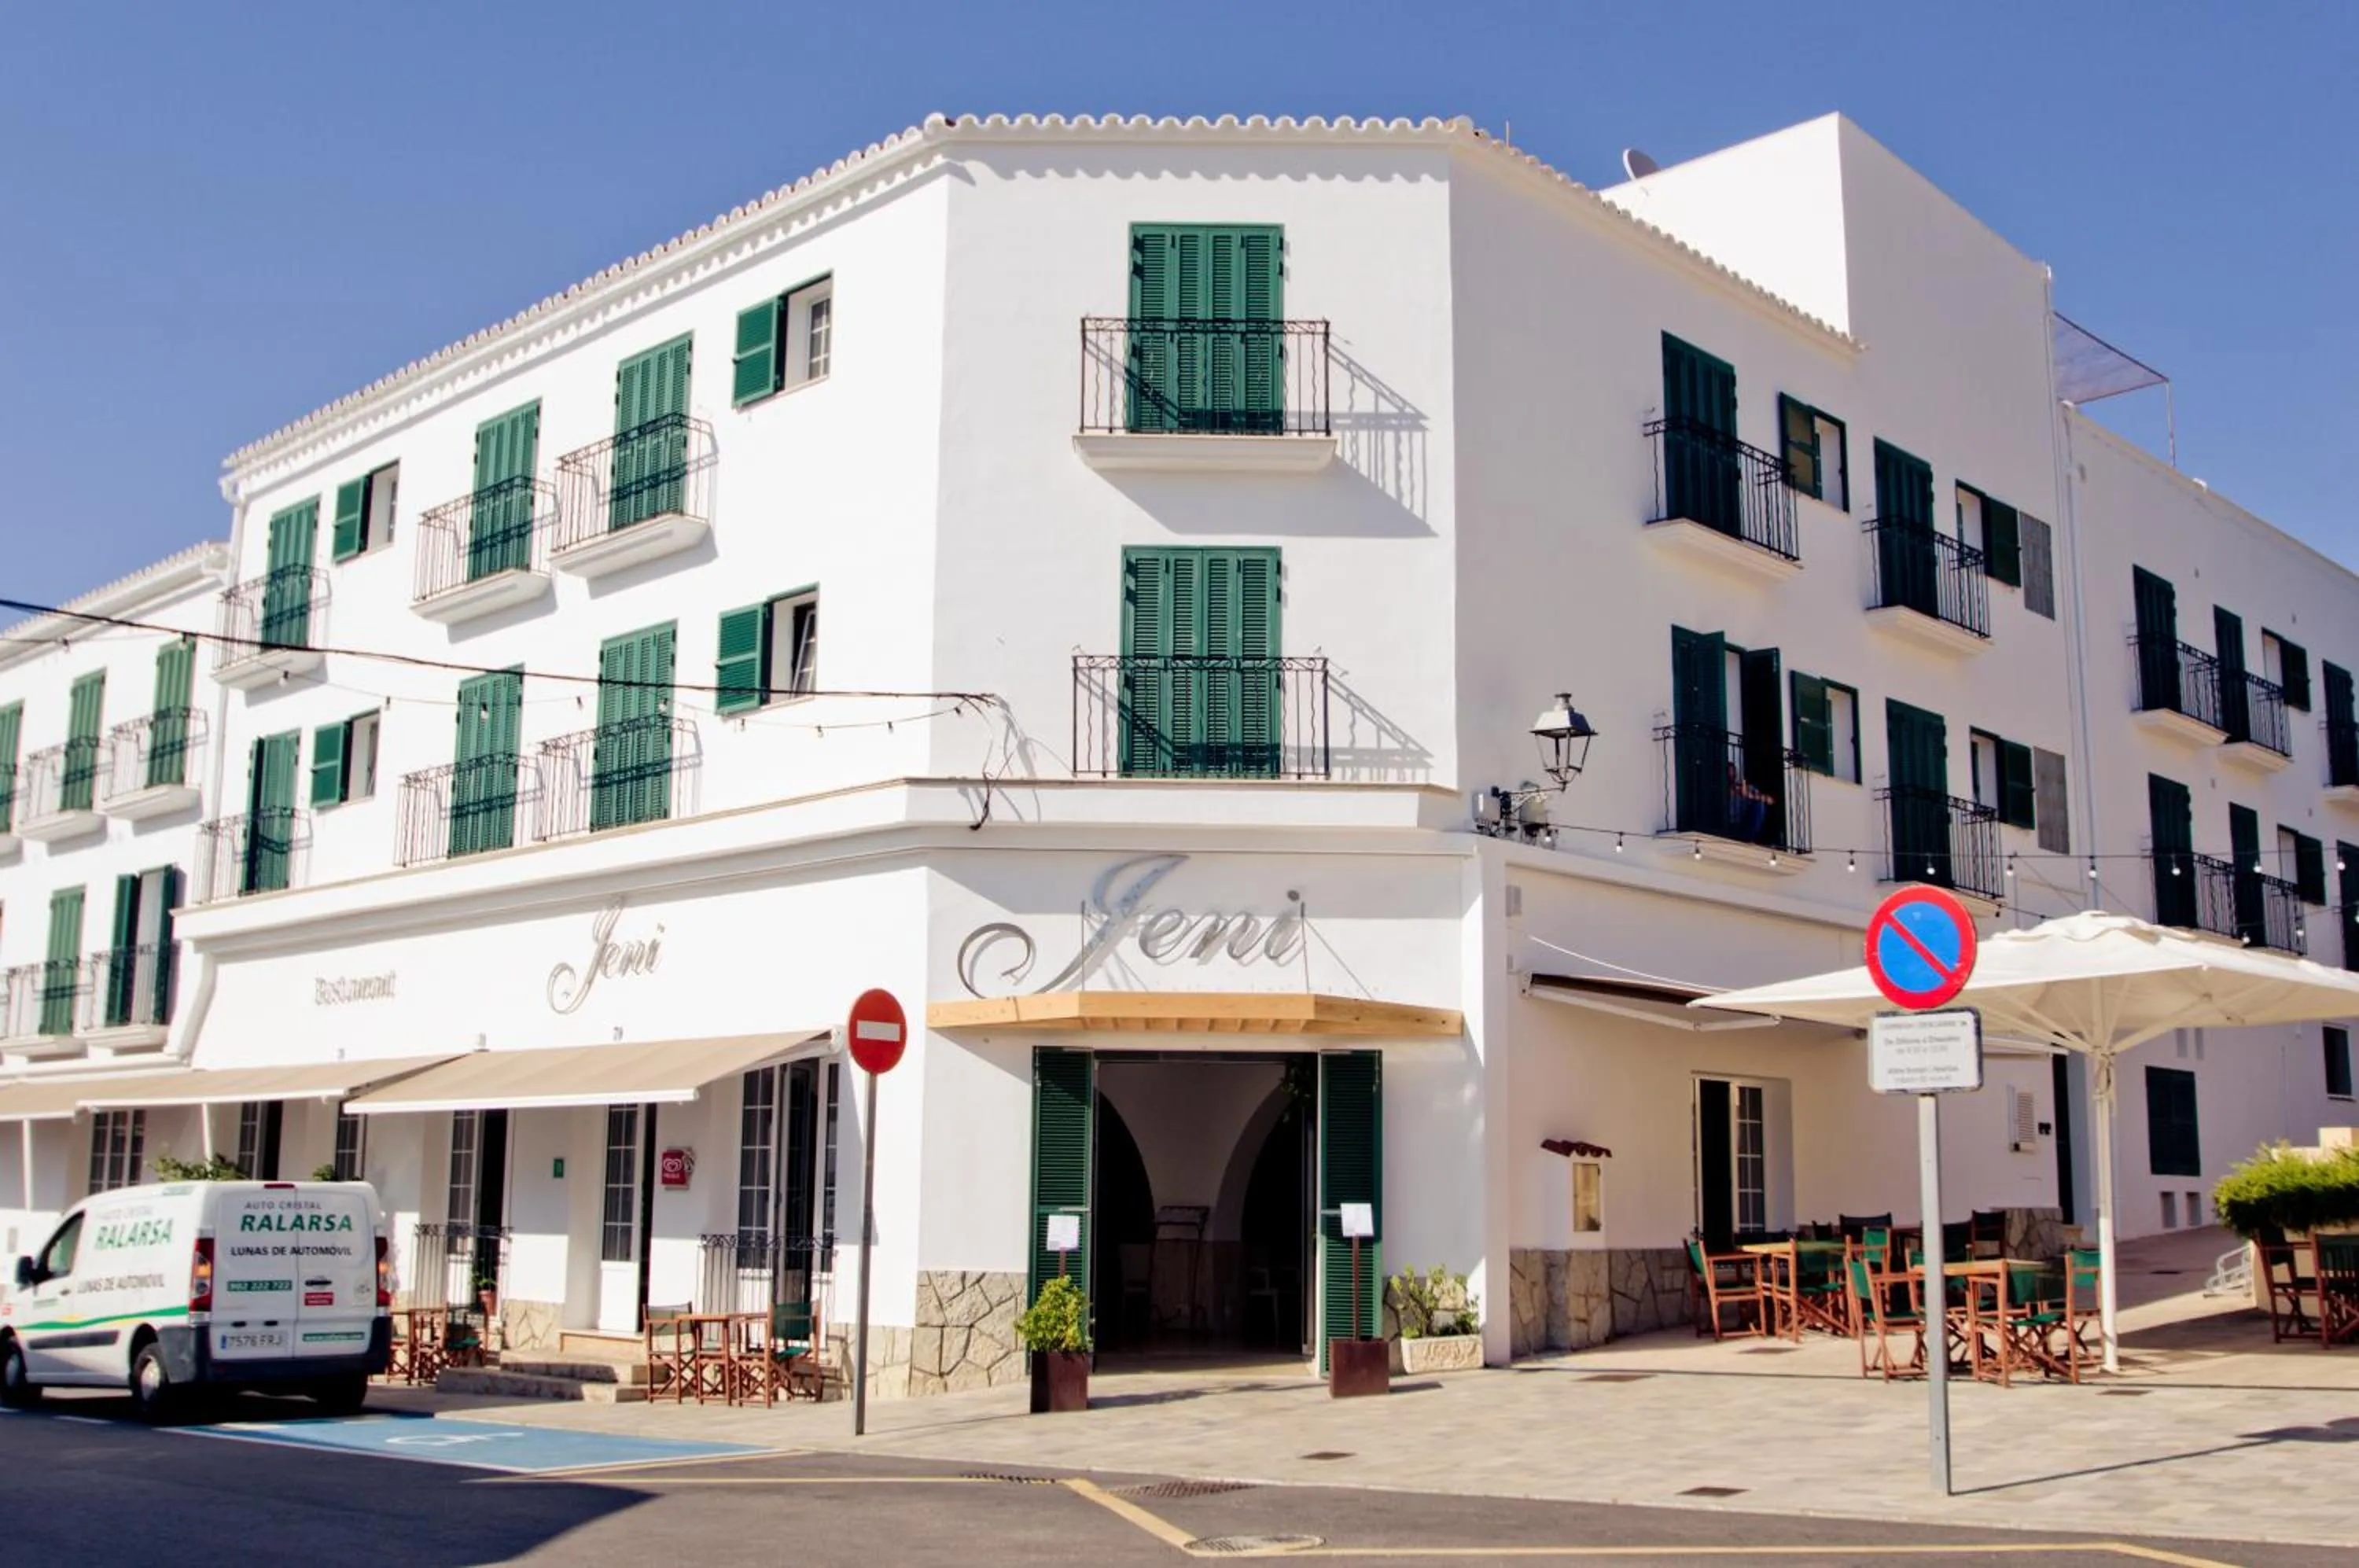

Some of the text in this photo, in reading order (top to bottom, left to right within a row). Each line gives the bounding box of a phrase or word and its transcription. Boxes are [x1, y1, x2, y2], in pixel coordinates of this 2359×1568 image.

[958, 854, 1302, 999] Jeni
[547, 893, 665, 1014] Jeni
[245, 1201, 322, 1209] AUTO CRISTAL
[94, 1218, 173, 1250] RALARSA
[241, 1213, 353, 1231] RALARSA
[230, 1246, 268, 1256] LUNAS
[271, 1246, 287, 1256] DE
